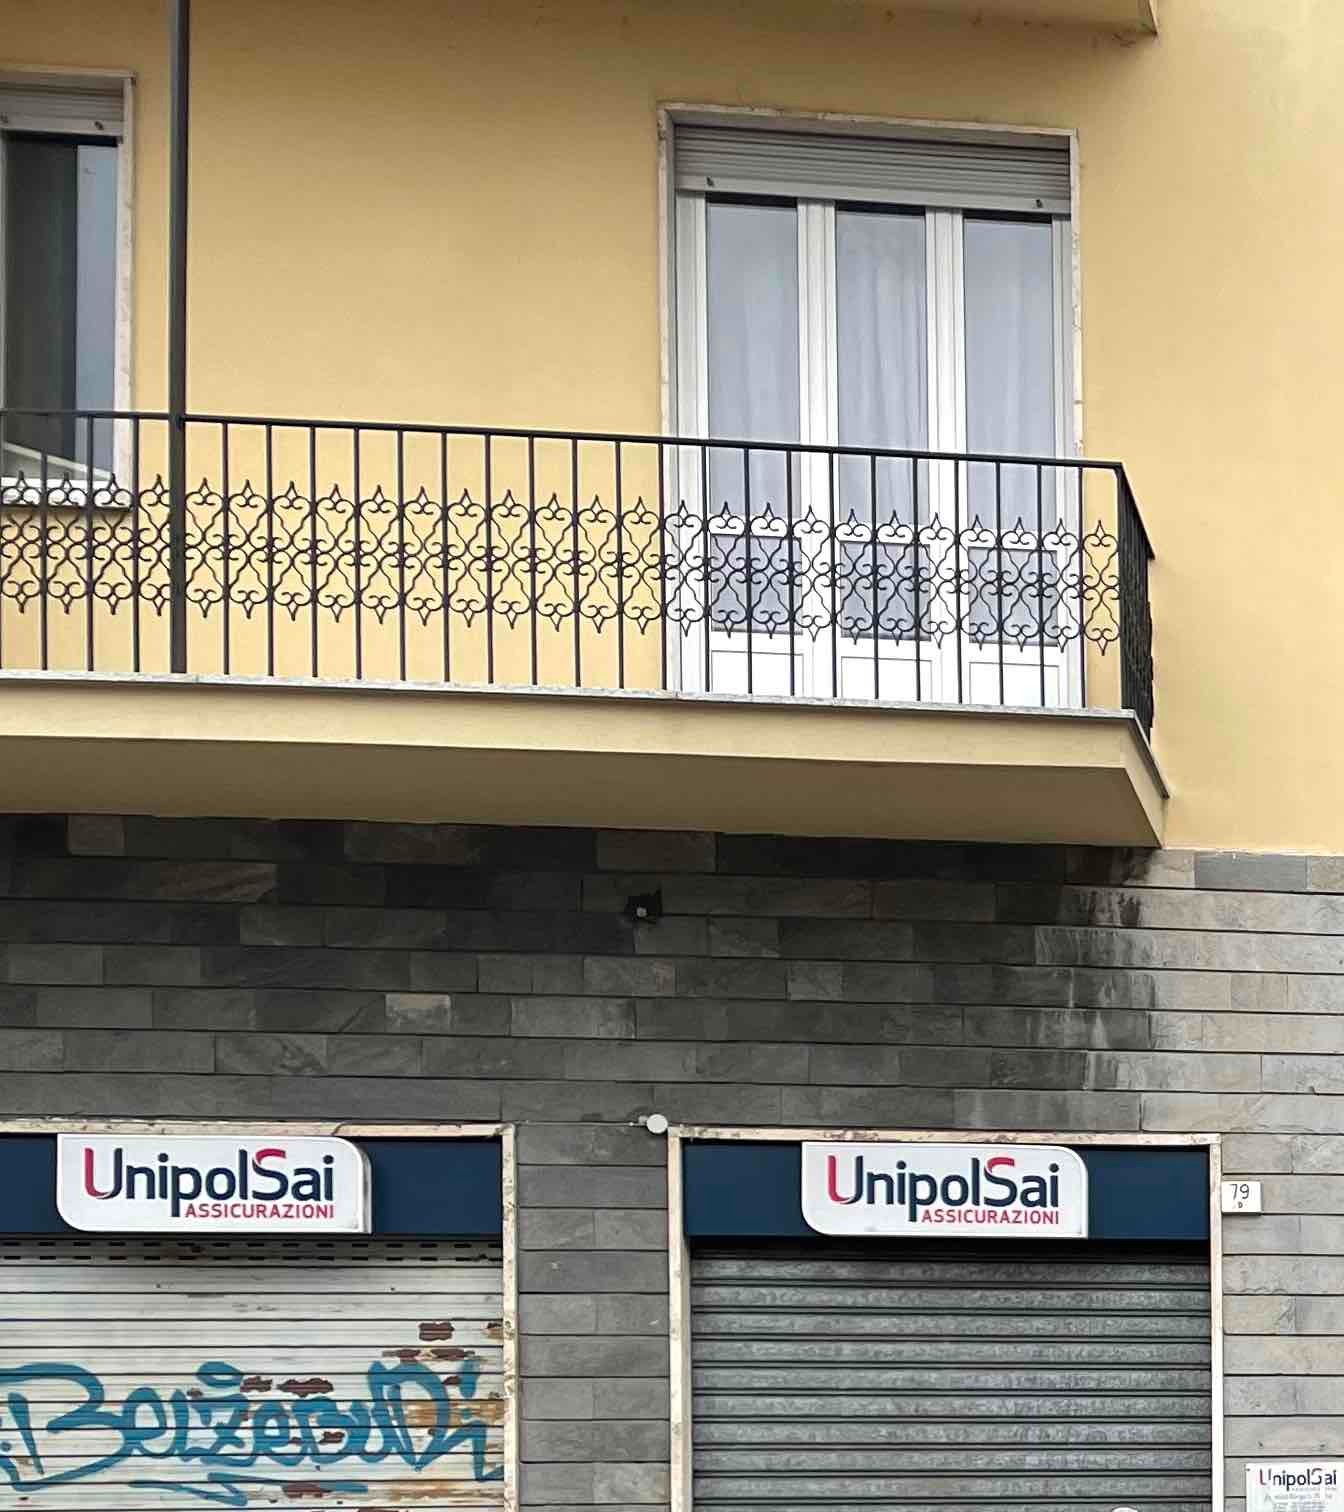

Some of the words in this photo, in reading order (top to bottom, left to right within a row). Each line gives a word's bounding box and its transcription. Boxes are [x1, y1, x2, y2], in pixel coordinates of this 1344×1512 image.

[84, 1146, 335, 1219] UnipolSai
[827, 1155, 1061, 1223] UnipolSai
[1229, 1183, 1250, 1200] 79
[185, 1203, 335, 1220] ASSICURAZIONI
[920, 1208, 1061, 1225] ASSICURAZIONI
[1258, 1467, 1337, 1492] UnipolSai
